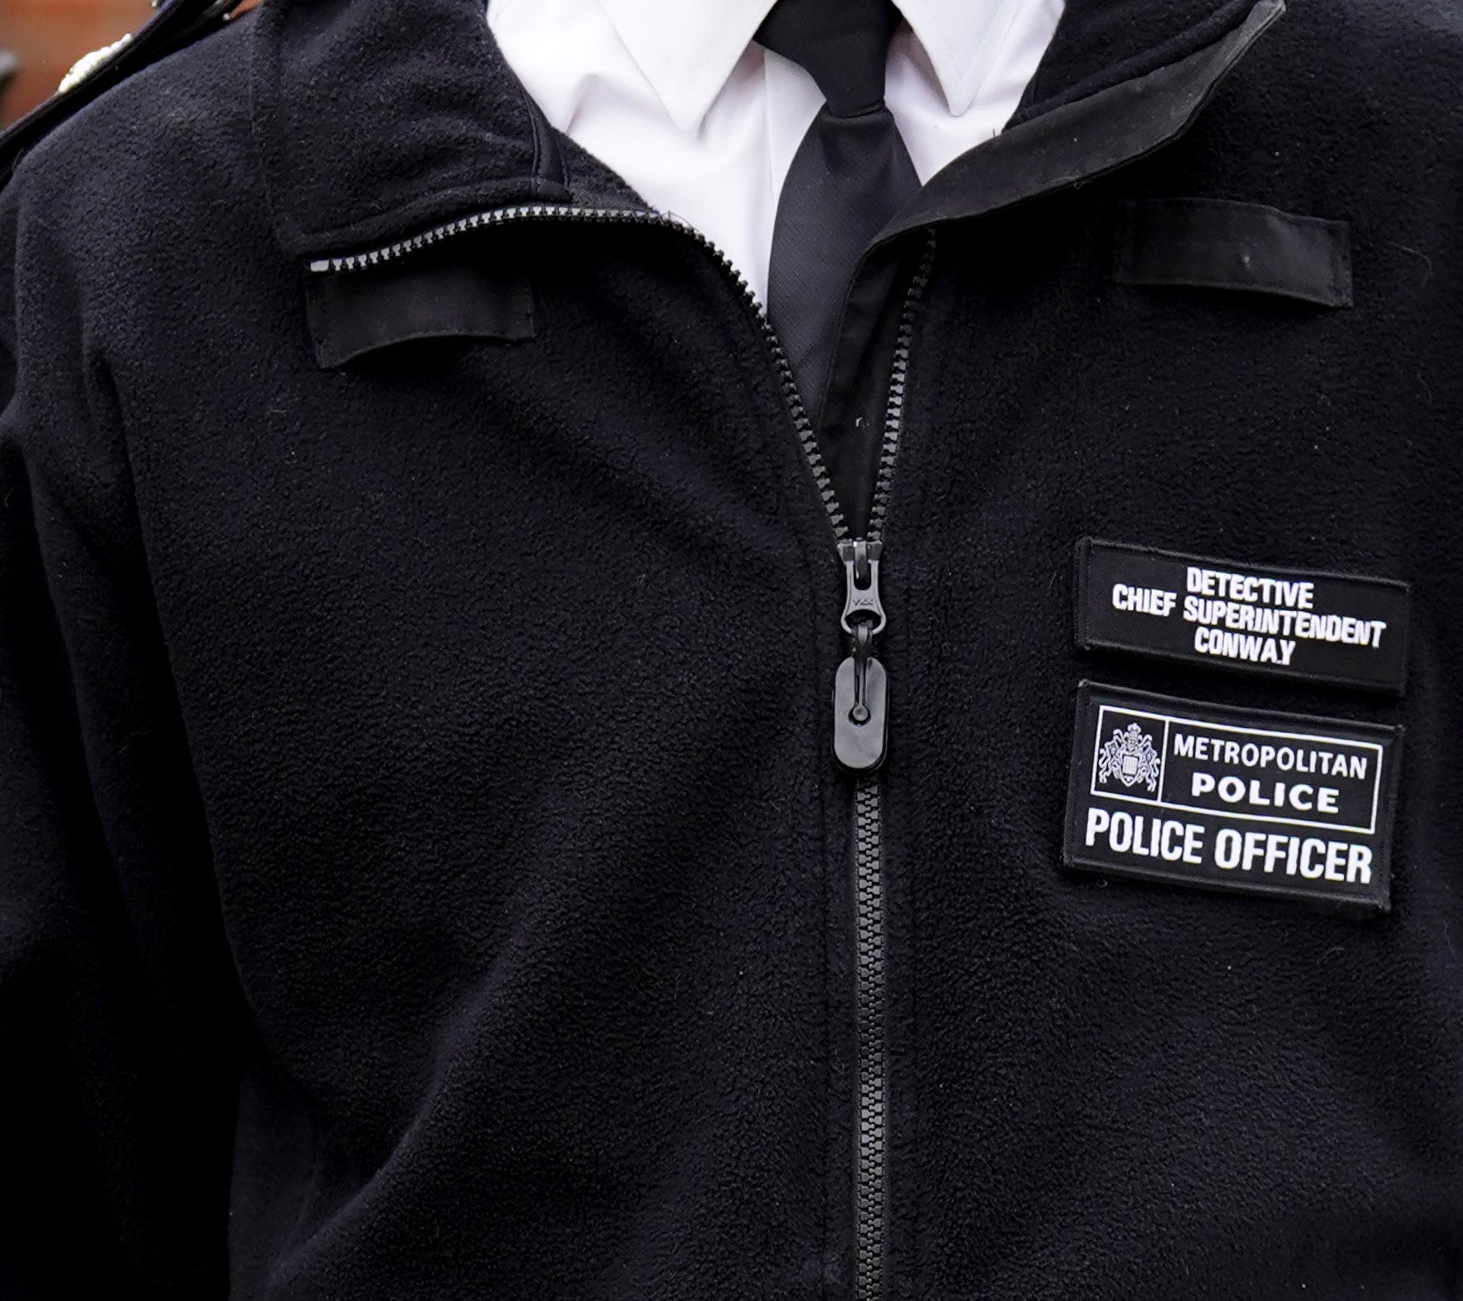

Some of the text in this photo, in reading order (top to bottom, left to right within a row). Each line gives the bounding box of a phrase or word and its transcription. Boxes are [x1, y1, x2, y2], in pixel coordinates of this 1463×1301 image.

[1186, 566, 1315, 609] DETECTIVE
[1112, 583, 1387, 649] CHIEF SUPERINTENDENT
[1194, 626, 1297, 666] CONWAY
[1173, 733, 1368, 780] METROPOLITAN
[1191, 772, 1340, 814] POLICE
[1085, 807, 1374, 885] POLICE OFFICER
